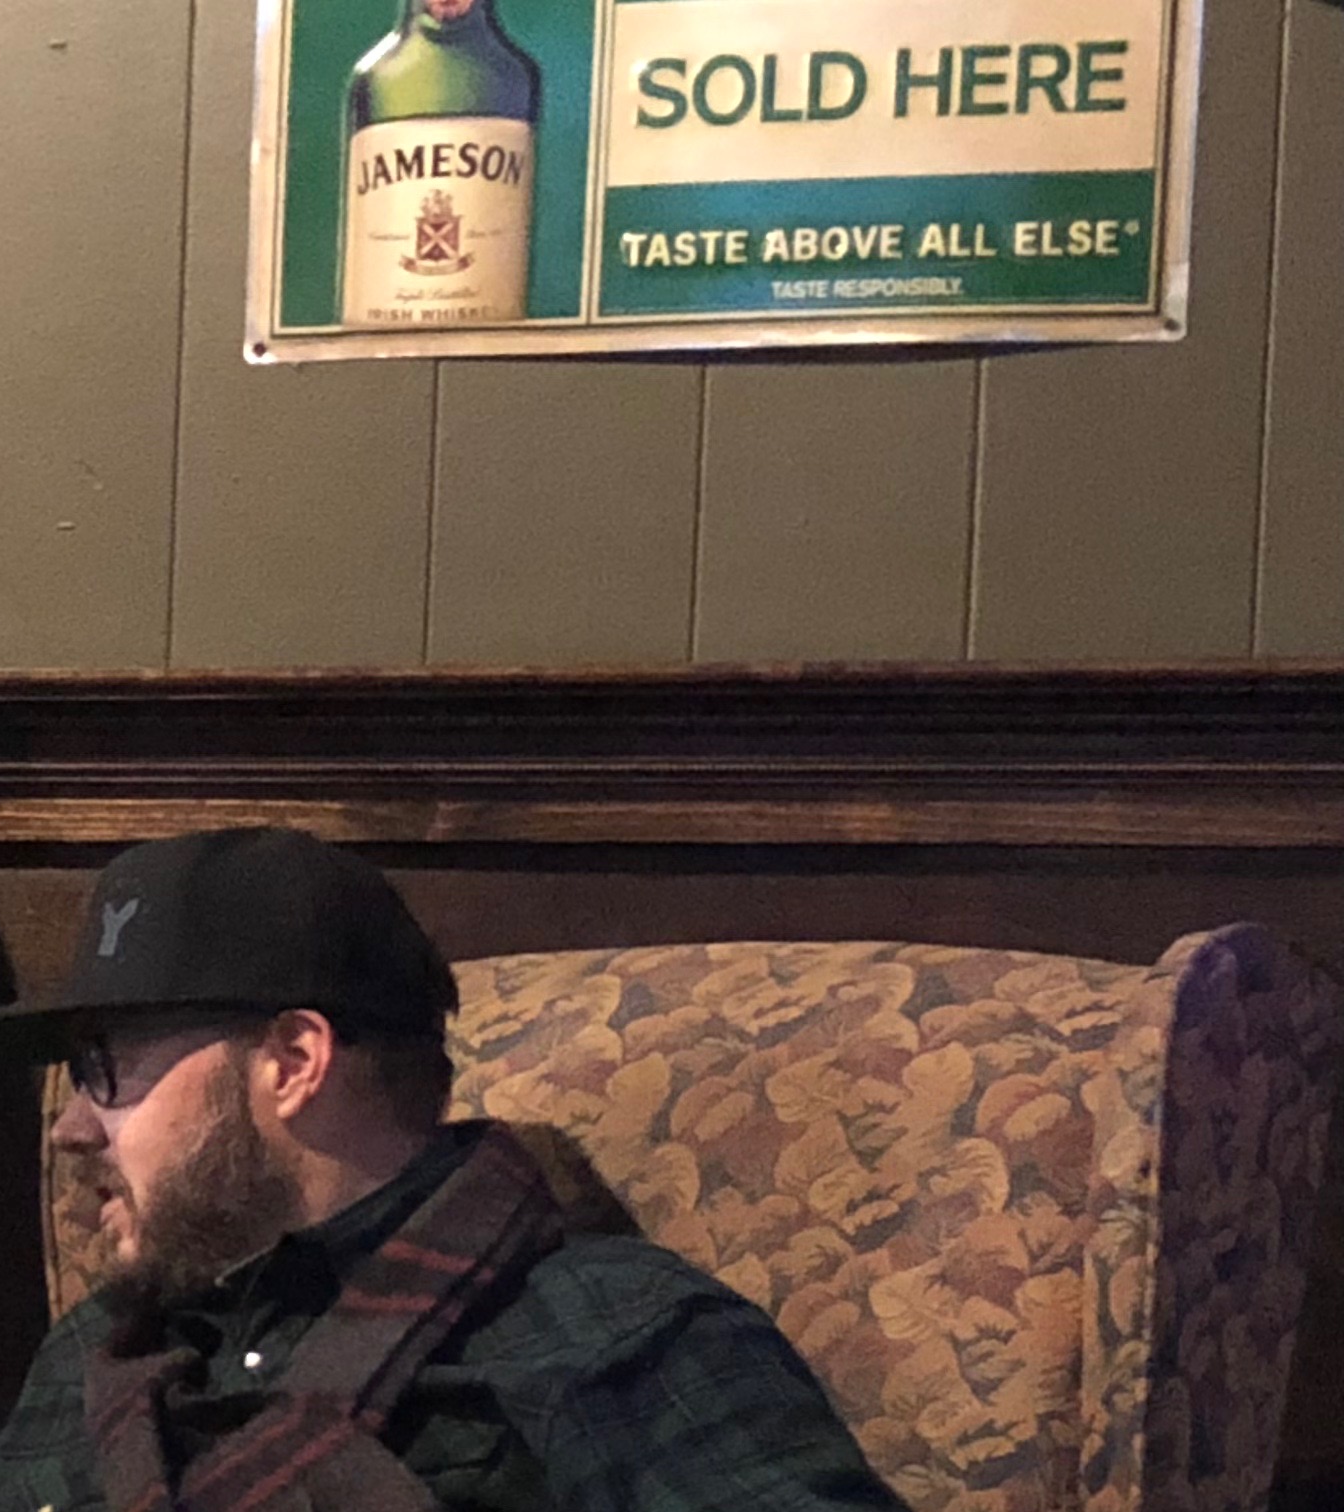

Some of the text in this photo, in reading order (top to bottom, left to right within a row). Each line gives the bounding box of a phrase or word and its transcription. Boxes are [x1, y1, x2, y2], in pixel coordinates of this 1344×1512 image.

[634, 40, 1129, 129] SOLD HERE
[356, 142, 524, 196] JAMESON
[622, 230, 749, 268] TASTE
[763, 225, 905, 264] ABOVE
[917, 222, 998, 258] ALL
[771, 276, 965, 300] TASTE RESPONSIBLY.
[367, 307, 413, 321] IRISH
